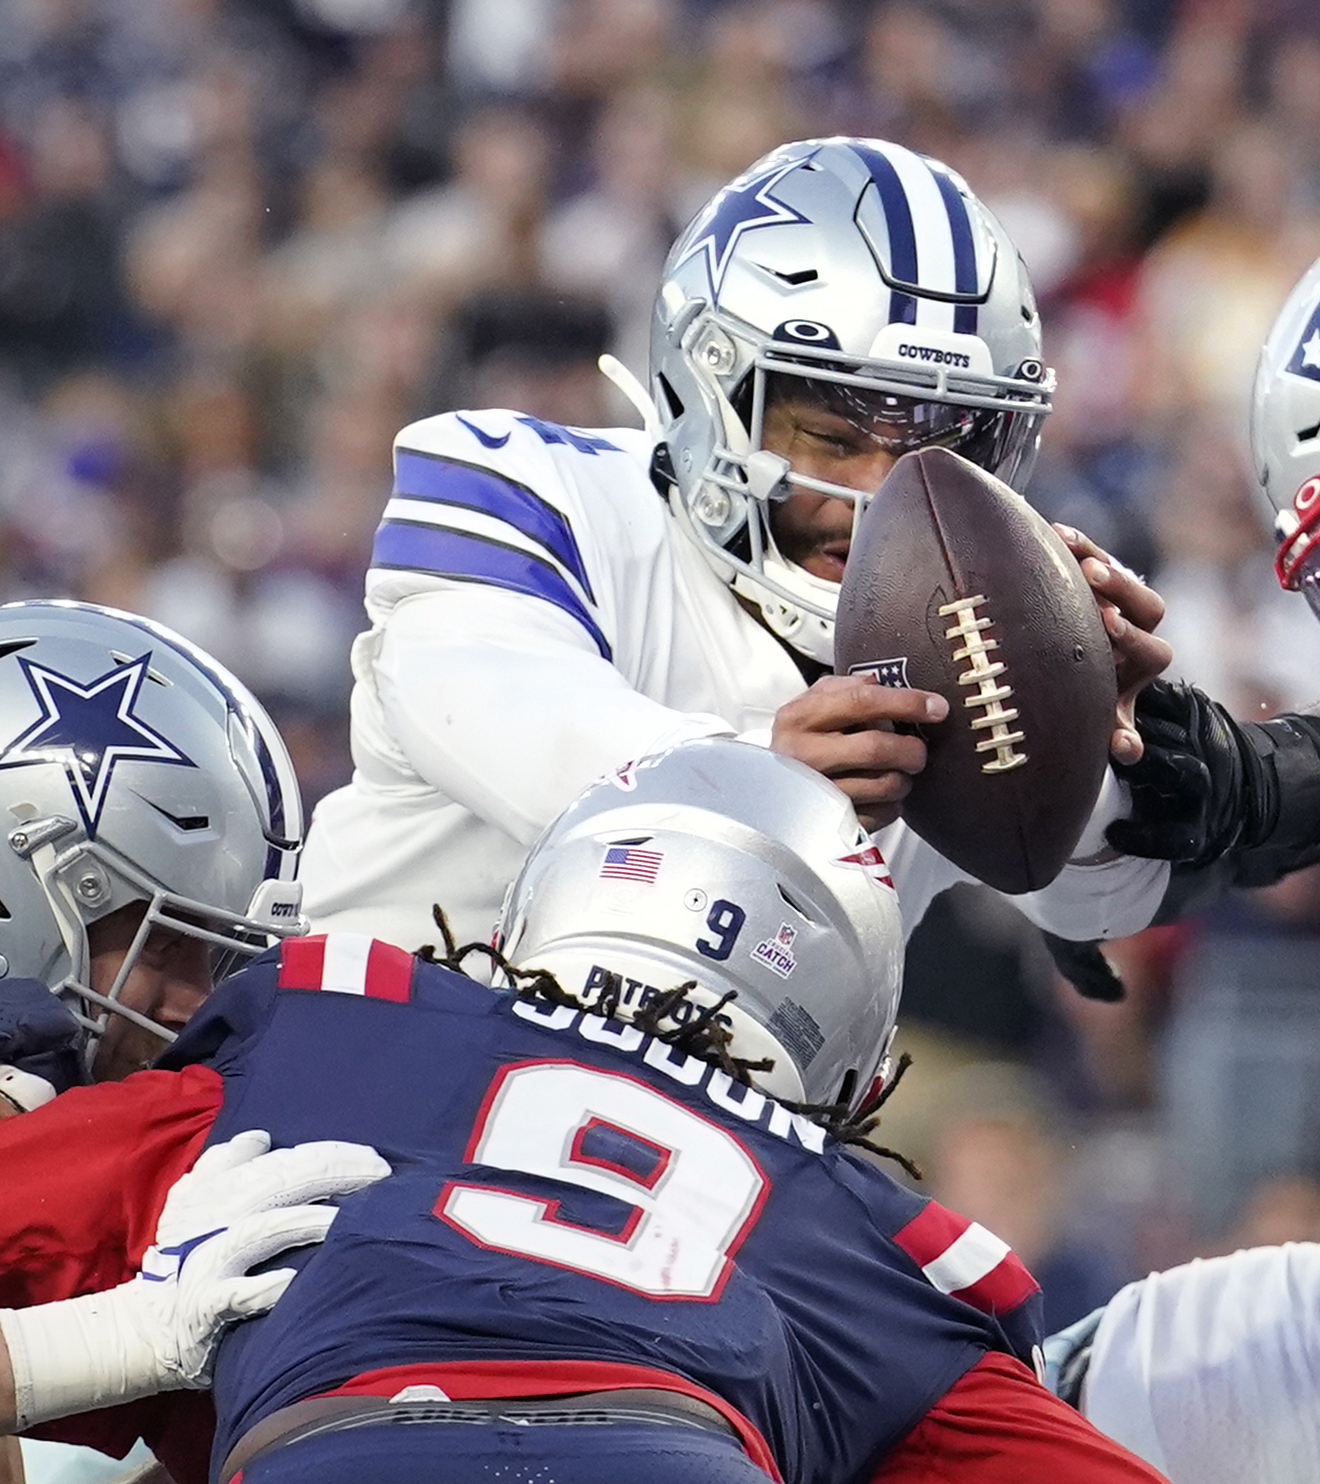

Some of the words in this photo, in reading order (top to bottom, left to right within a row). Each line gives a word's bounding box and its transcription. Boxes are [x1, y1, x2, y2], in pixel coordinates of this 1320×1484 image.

[898, 344, 971, 369] COWBOYS
[695, 898, 747, 961] 9
[756, 943, 795, 973] CATCH
[431, 1057, 773, 1304] 9
